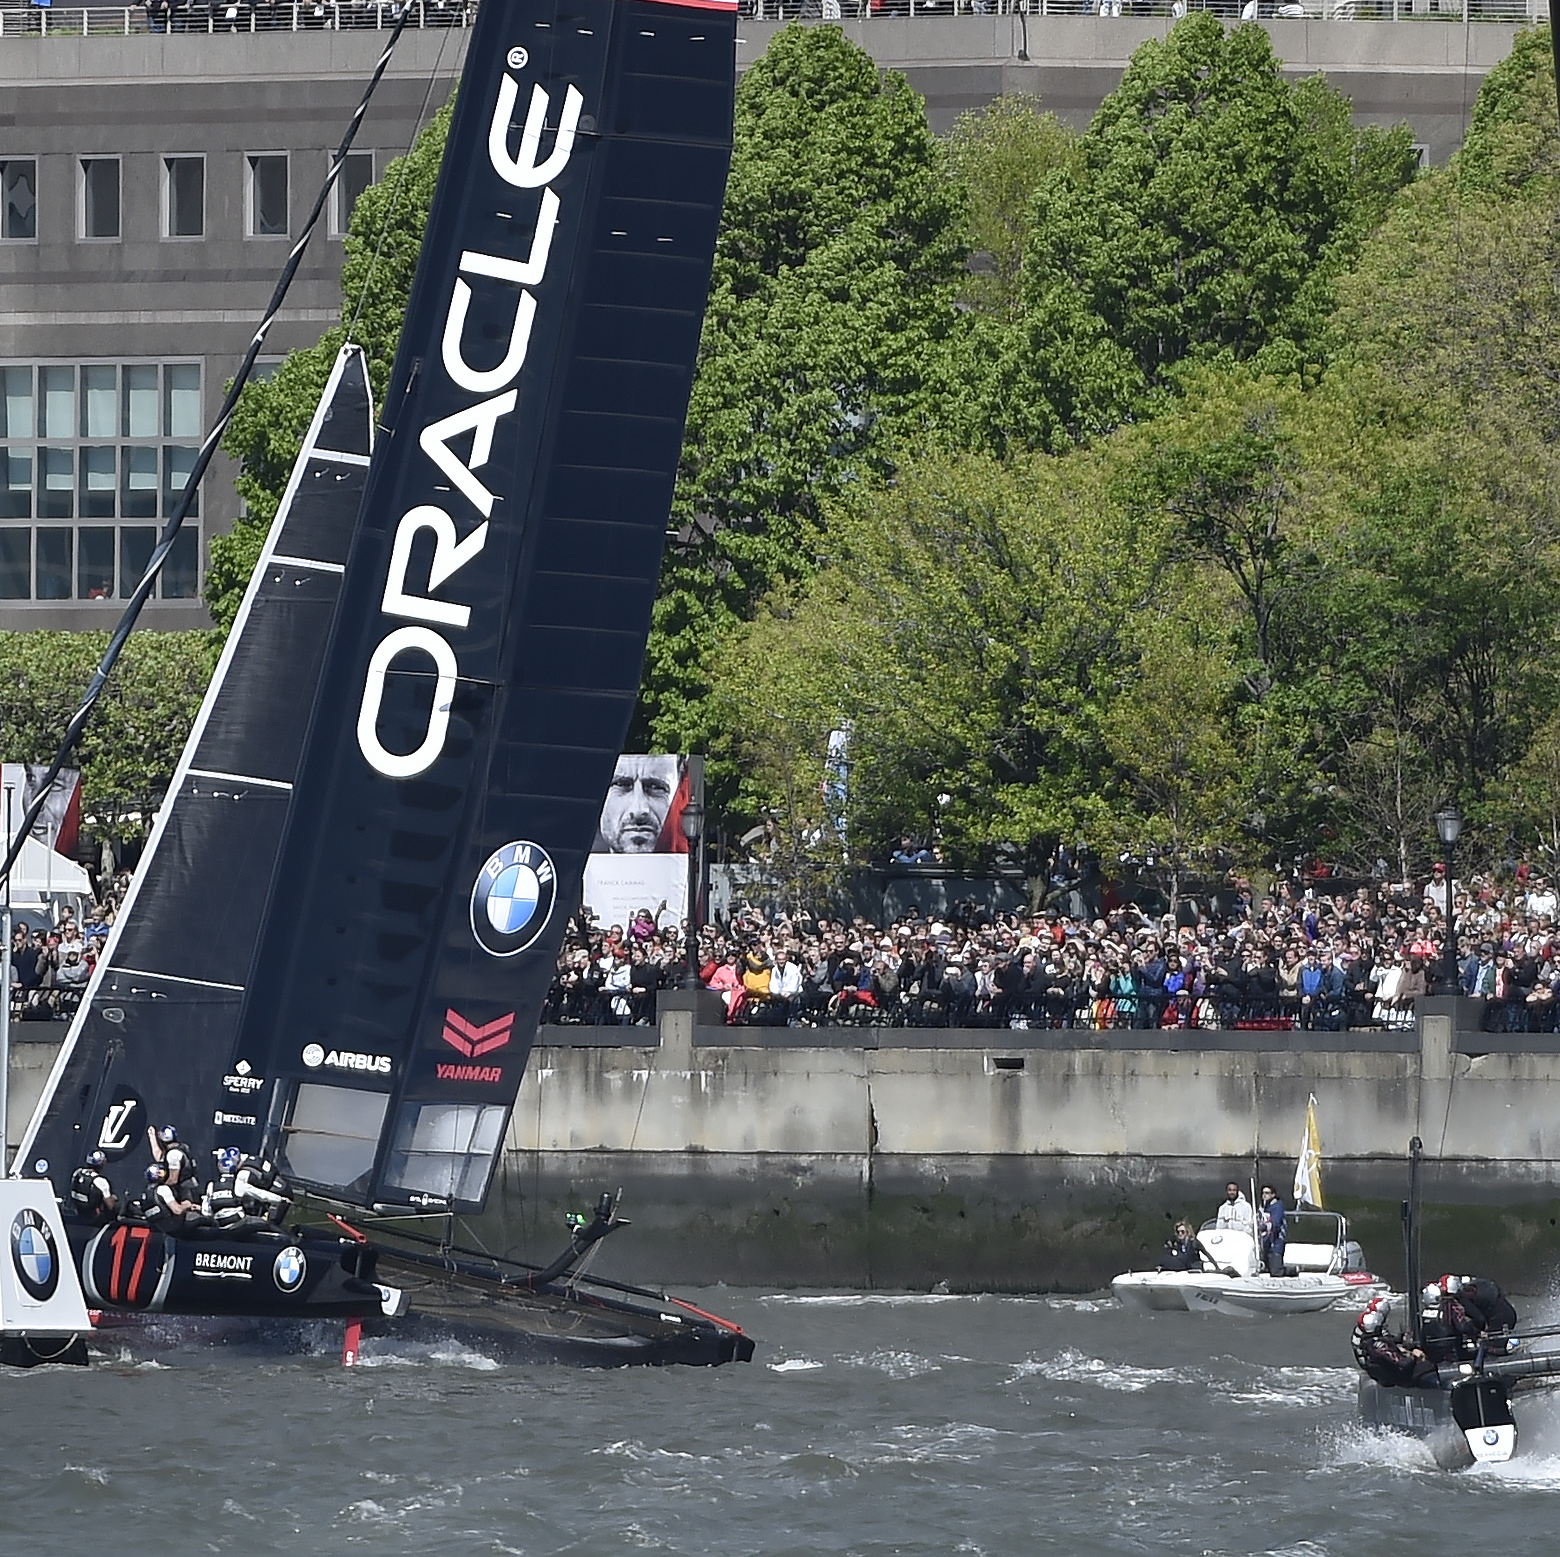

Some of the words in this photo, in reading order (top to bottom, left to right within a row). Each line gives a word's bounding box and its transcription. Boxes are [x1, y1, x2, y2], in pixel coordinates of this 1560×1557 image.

[486, 845, 552, 884] BMW
[324, 1050, 391, 1073] AIRBUS
[436, 1063, 502, 1083] YANMAR
[12, 1210, 53, 1240] BMW
[111, 1225, 151, 1302] 17
[195, 1253, 253, 1271] BREMONT
